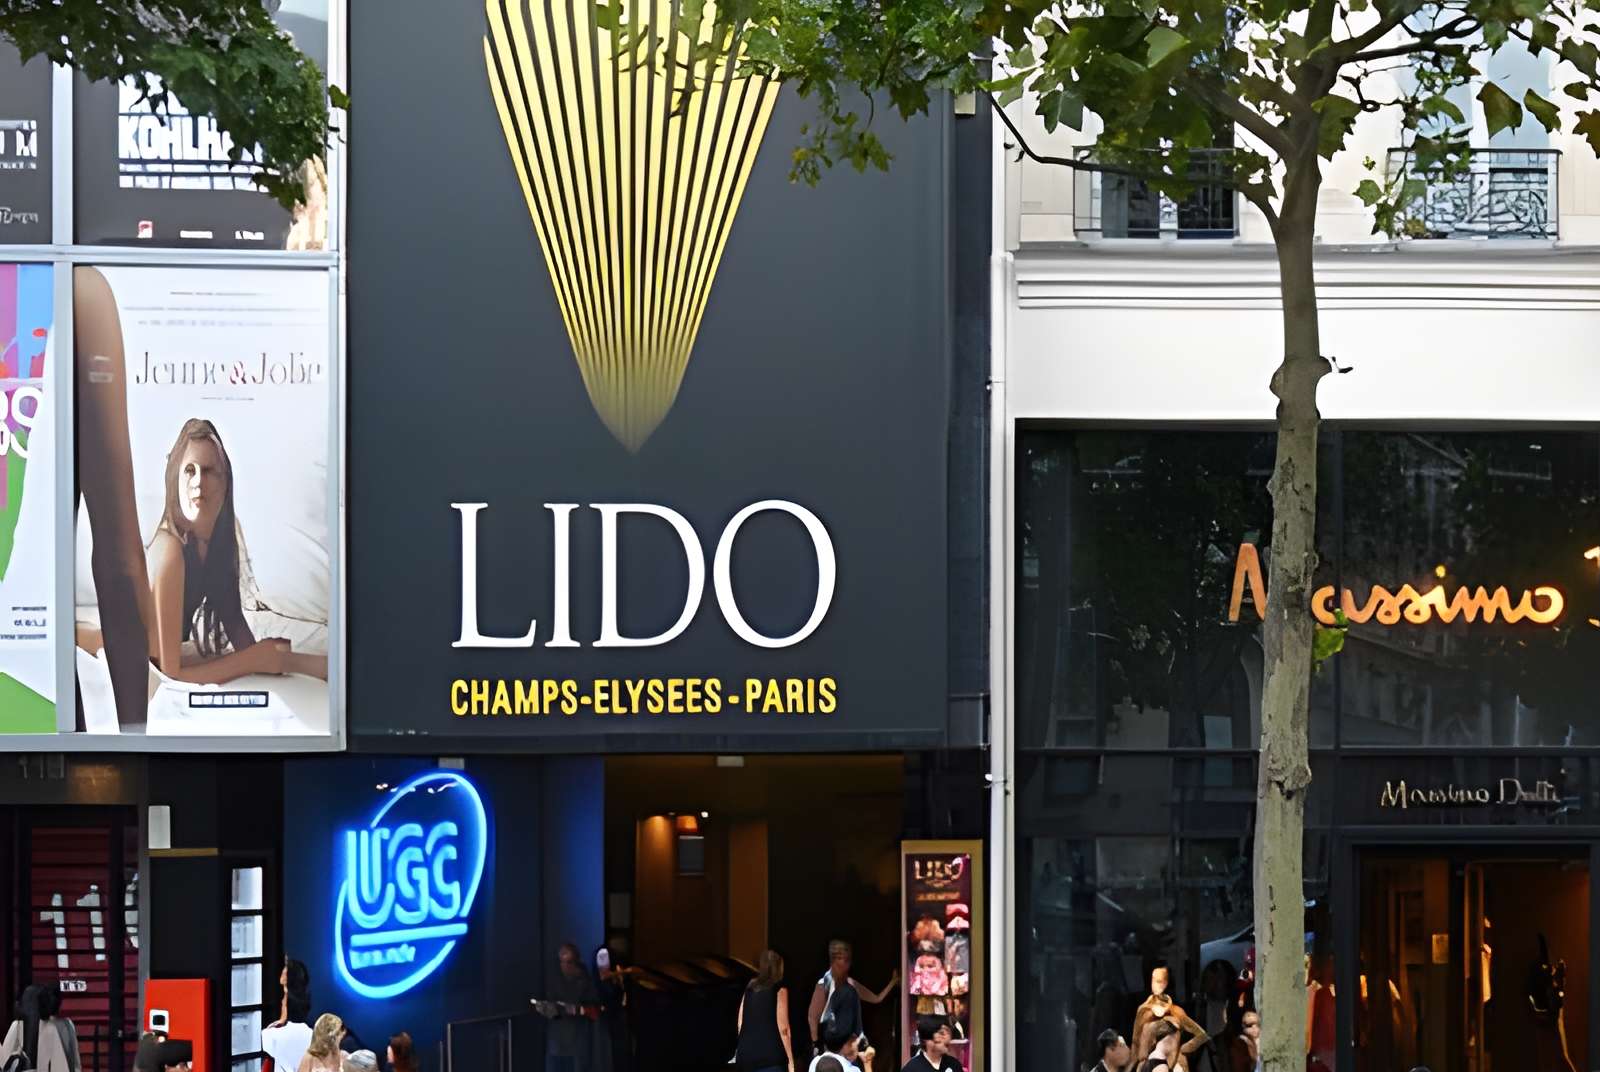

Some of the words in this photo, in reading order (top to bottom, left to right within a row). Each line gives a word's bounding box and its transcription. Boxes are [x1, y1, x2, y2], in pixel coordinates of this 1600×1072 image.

[119, 115, 264, 162] KOHLH
[451, 500, 836, 648] LIDO
[347, 822, 461, 929] UGC
